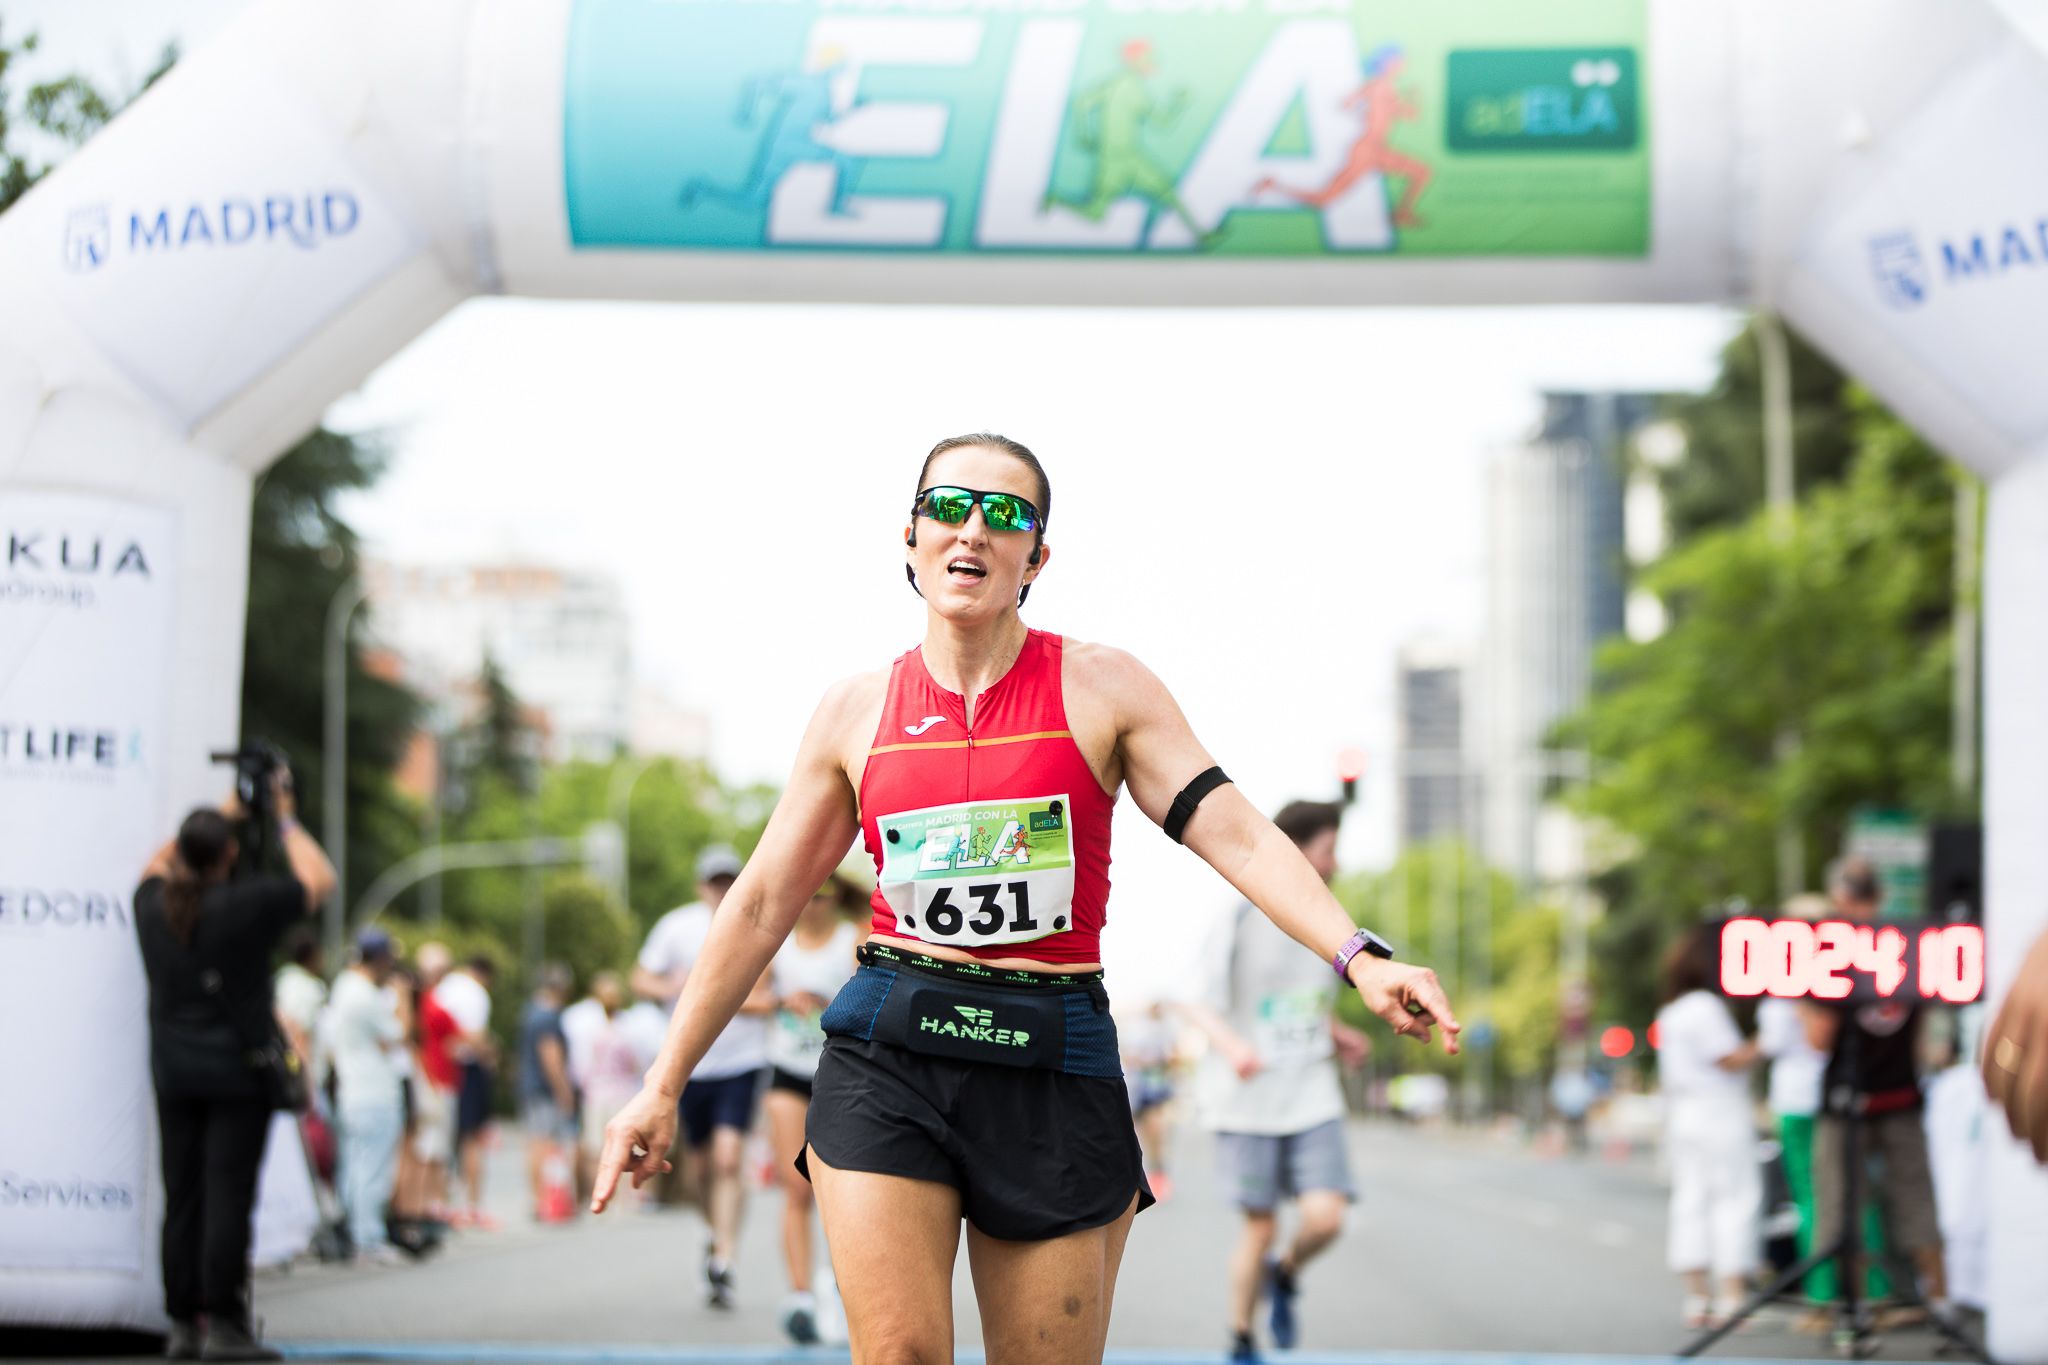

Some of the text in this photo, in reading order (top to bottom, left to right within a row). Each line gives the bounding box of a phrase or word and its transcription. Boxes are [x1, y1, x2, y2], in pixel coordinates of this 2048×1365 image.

[766, 17, 1395, 251] ELA
[129, 191, 359, 250] MADRID
[925, 812, 972, 827] MADRID
[975, 811, 1000, 822] CON
[1003, 809, 1018, 820] LA
[918, 820, 1030, 872] ELA
[925, 881, 1038, 936] 631
[956, 967, 992, 977] HANKER
[920, 1016, 1030, 1048] HANKER
